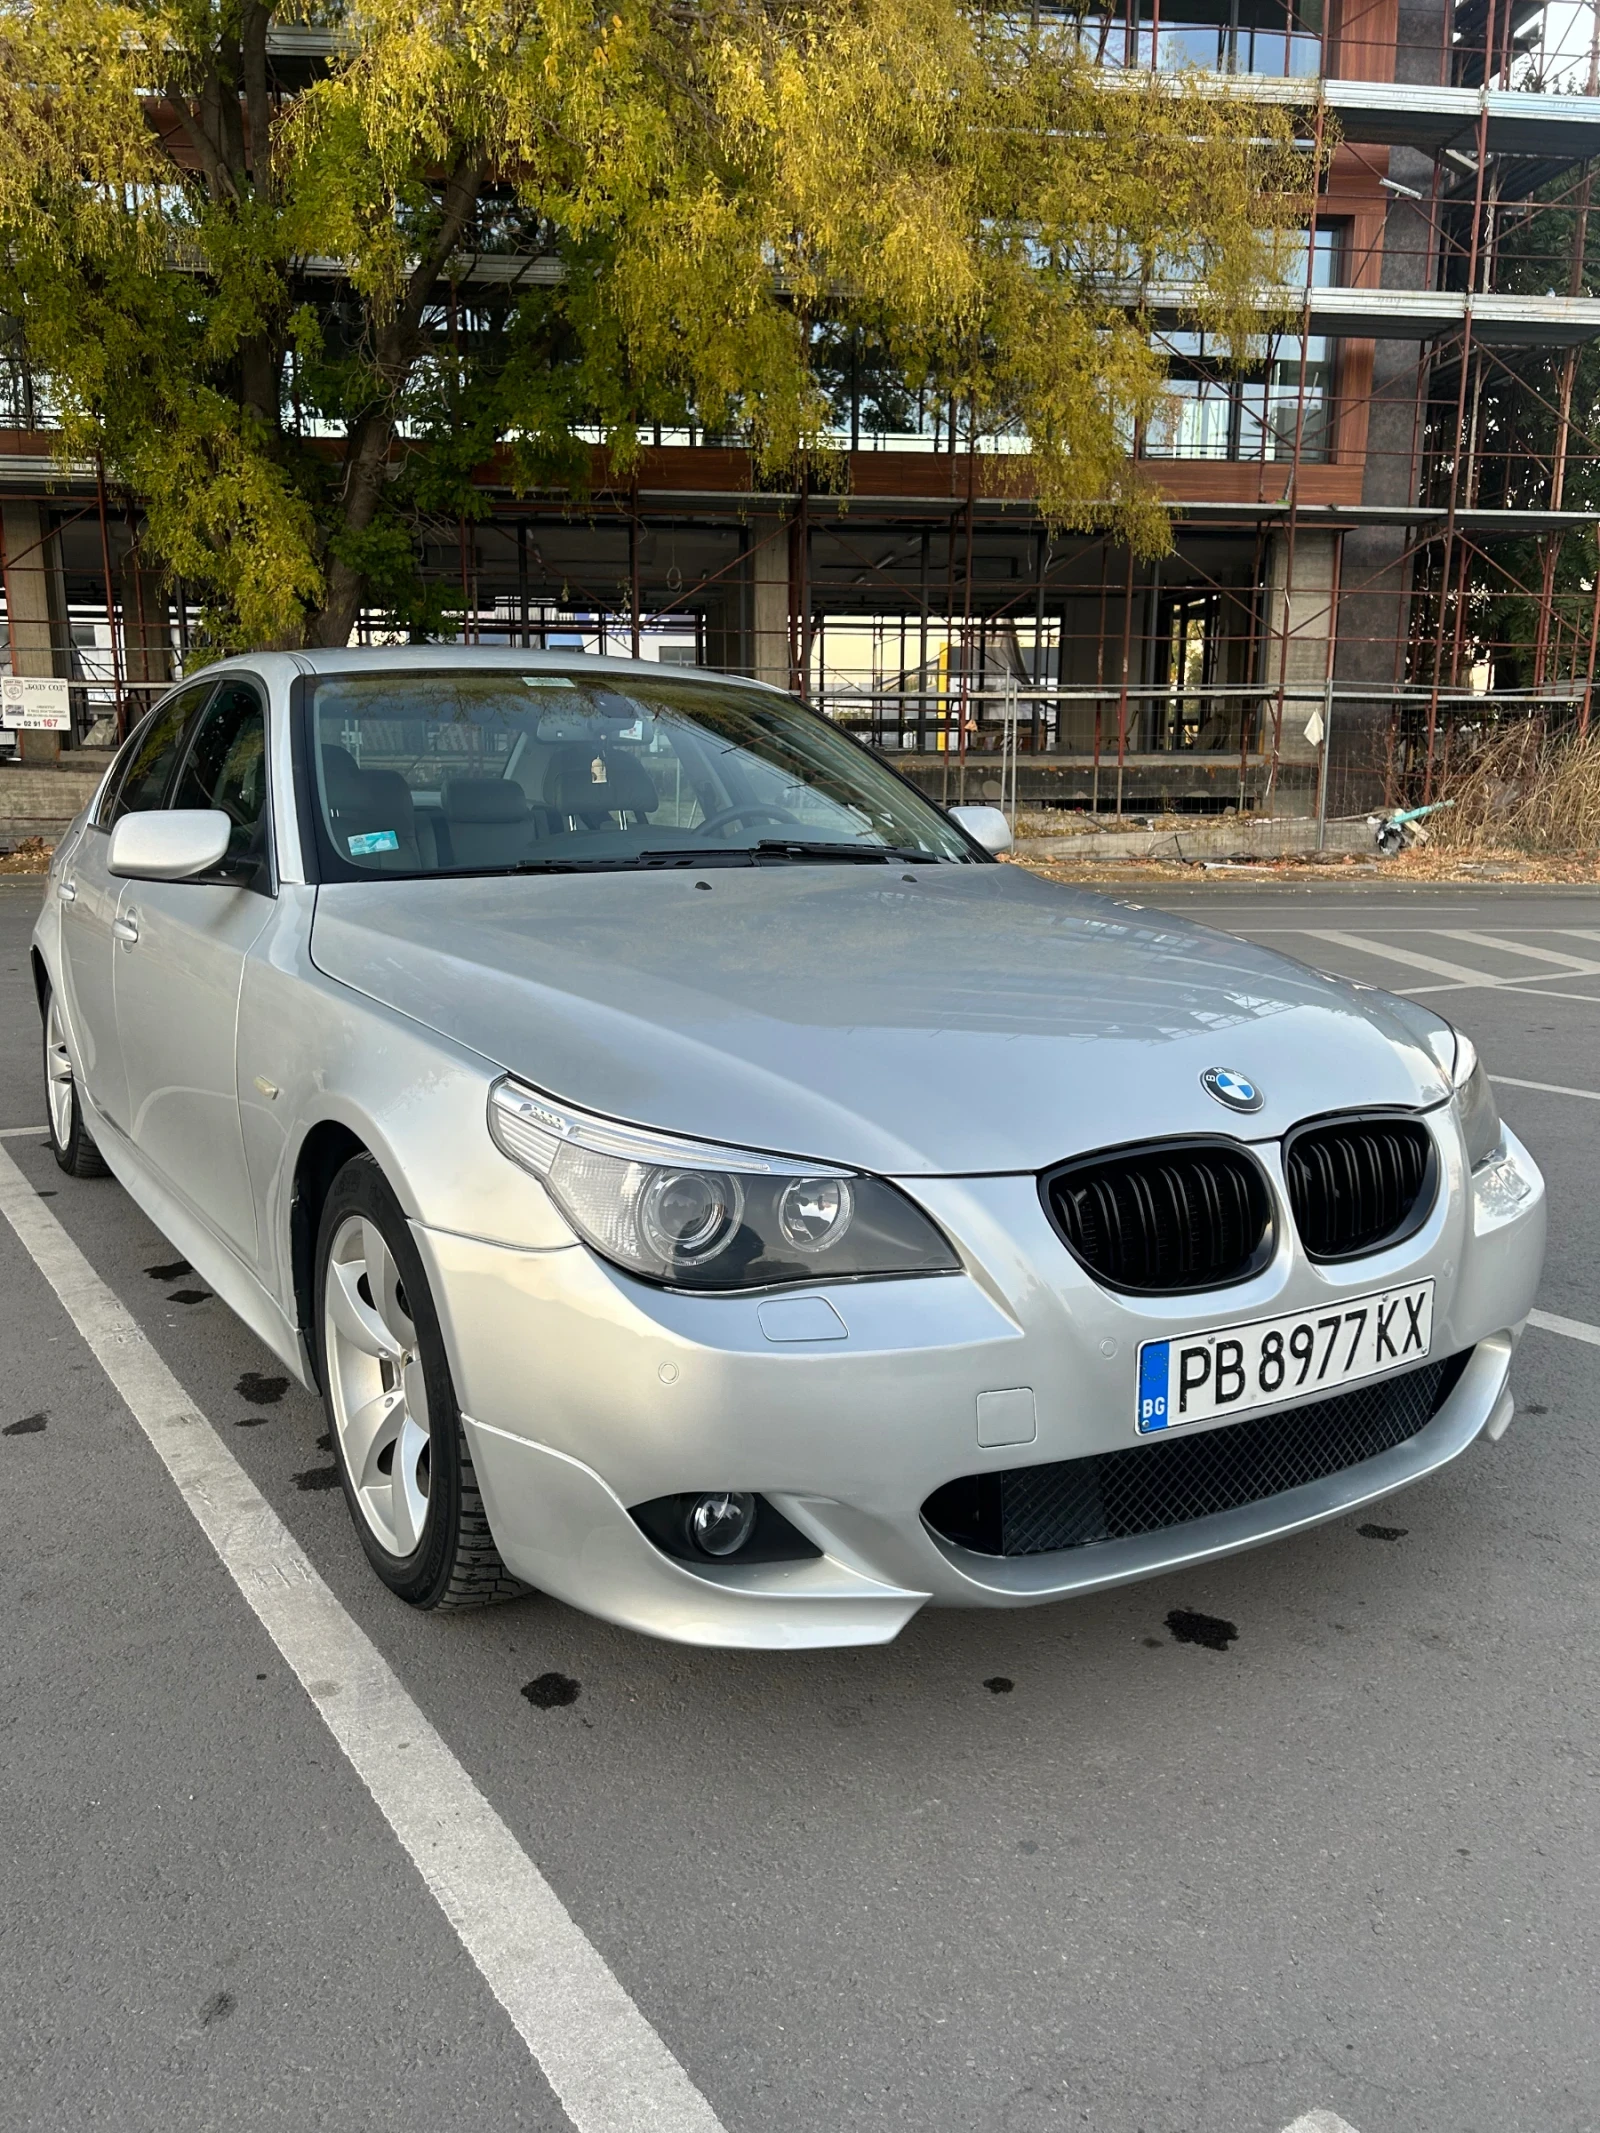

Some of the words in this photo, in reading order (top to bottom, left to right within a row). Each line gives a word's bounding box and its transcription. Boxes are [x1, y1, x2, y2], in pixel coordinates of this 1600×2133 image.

[43, 719, 58, 728] 167
[1178, 1339, 1246, 1413] PB
[1258, 1308, 1368, 1392] 8977
[1376, 1291, 1426, 1363] KX
[1142, 1397, 1165, 1418] BG
